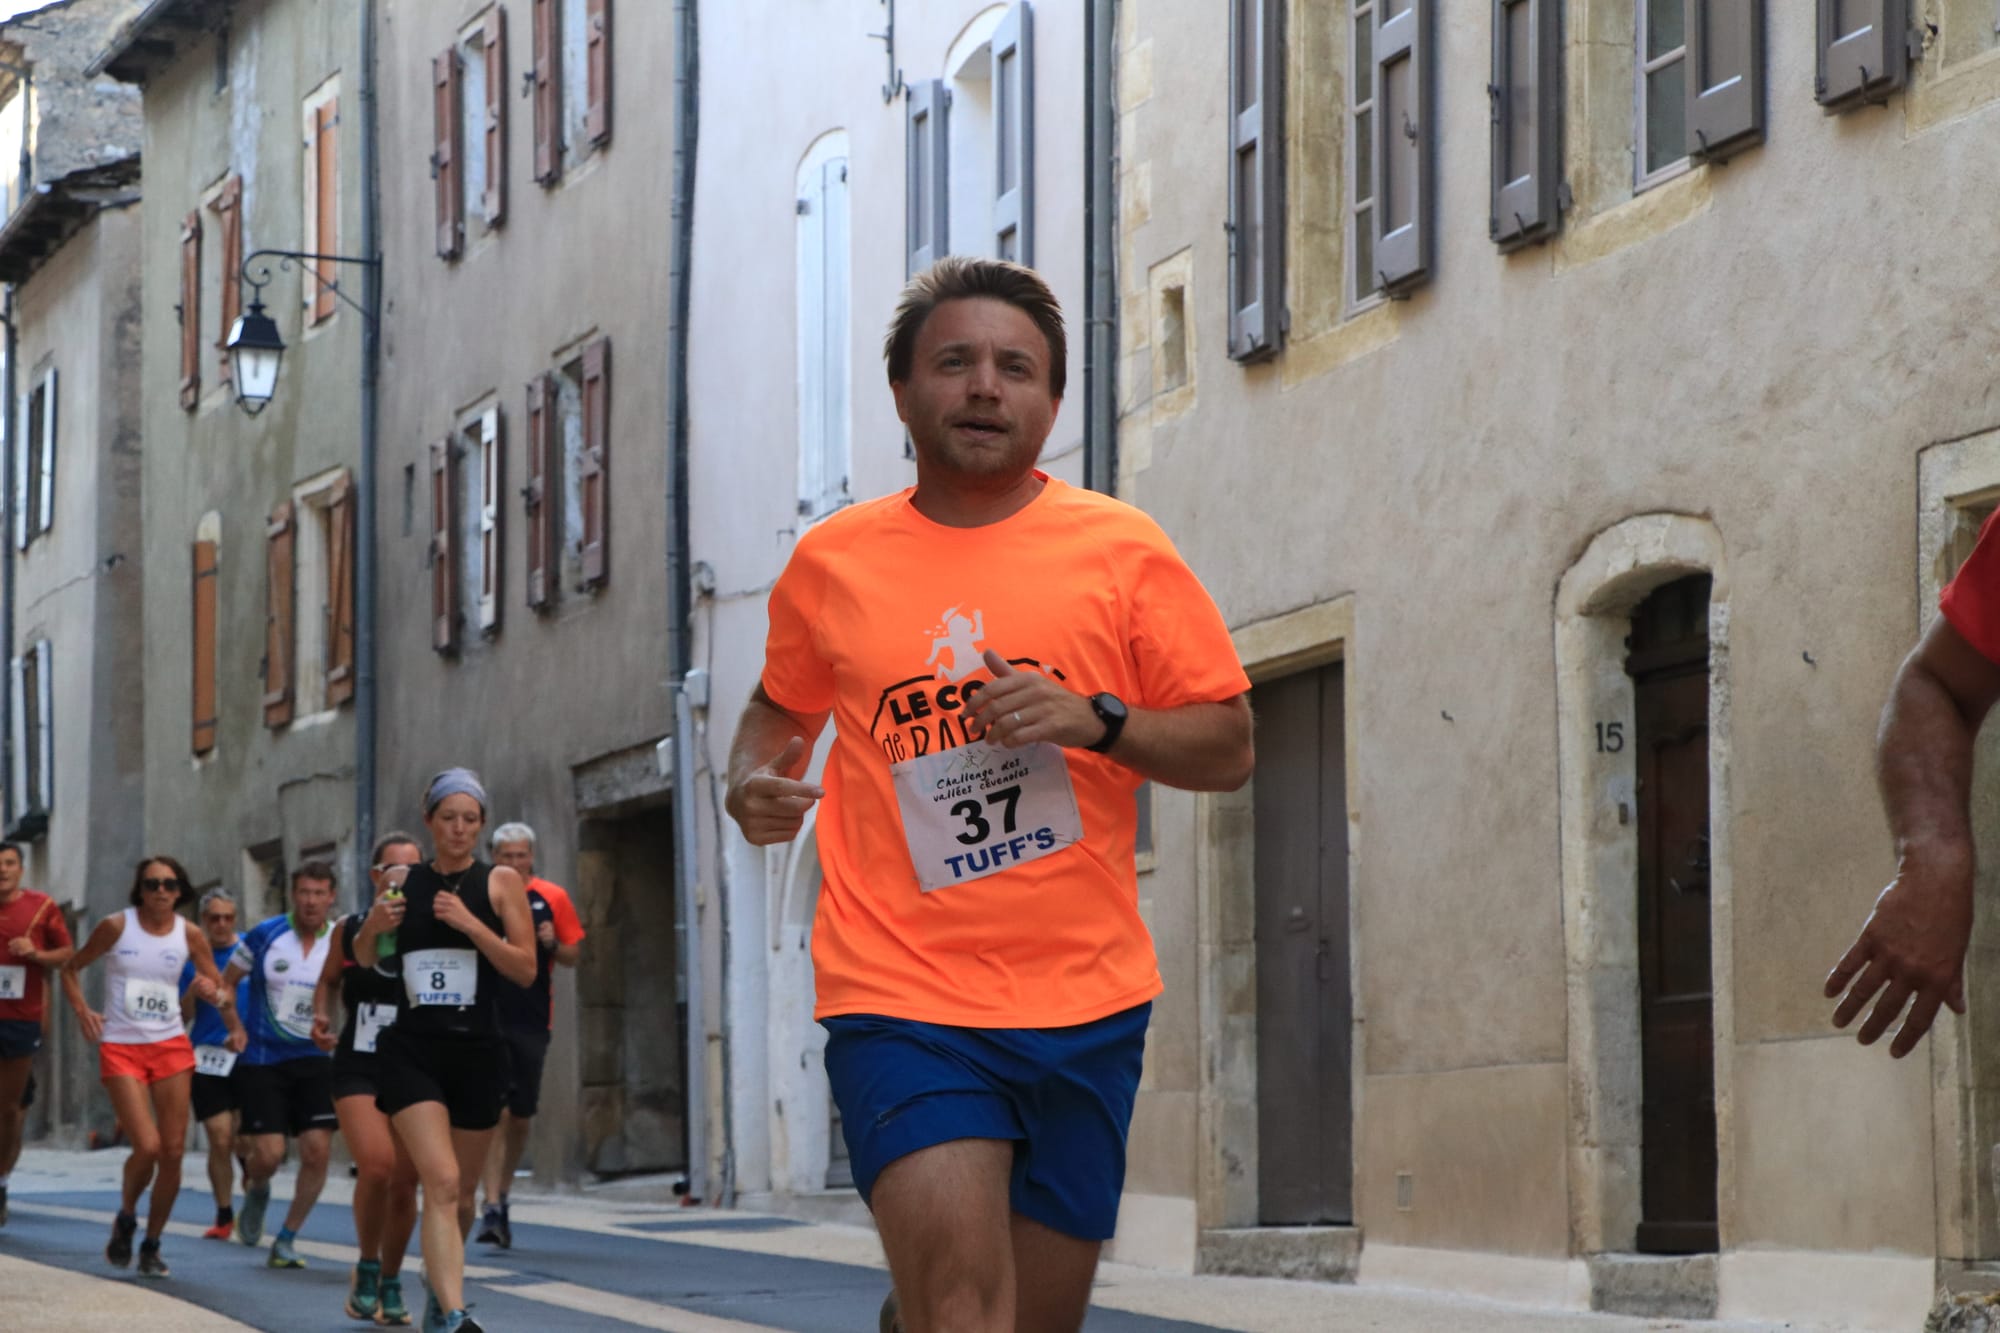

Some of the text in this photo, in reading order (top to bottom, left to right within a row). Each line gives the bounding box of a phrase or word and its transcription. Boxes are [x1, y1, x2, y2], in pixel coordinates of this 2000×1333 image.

[888, 690, 933, 726] LE
[882, 733, 906, 764] de
[1595, 721, 1625, 753] 15
[936, 758, 1021, 790] Challenge des
[950, 784, 1022, 845] 37
[943, 826, 1056, 878] TUFF'S
[431, 971, 446, 991] 8
[136, 995, 169, 1013] 106
